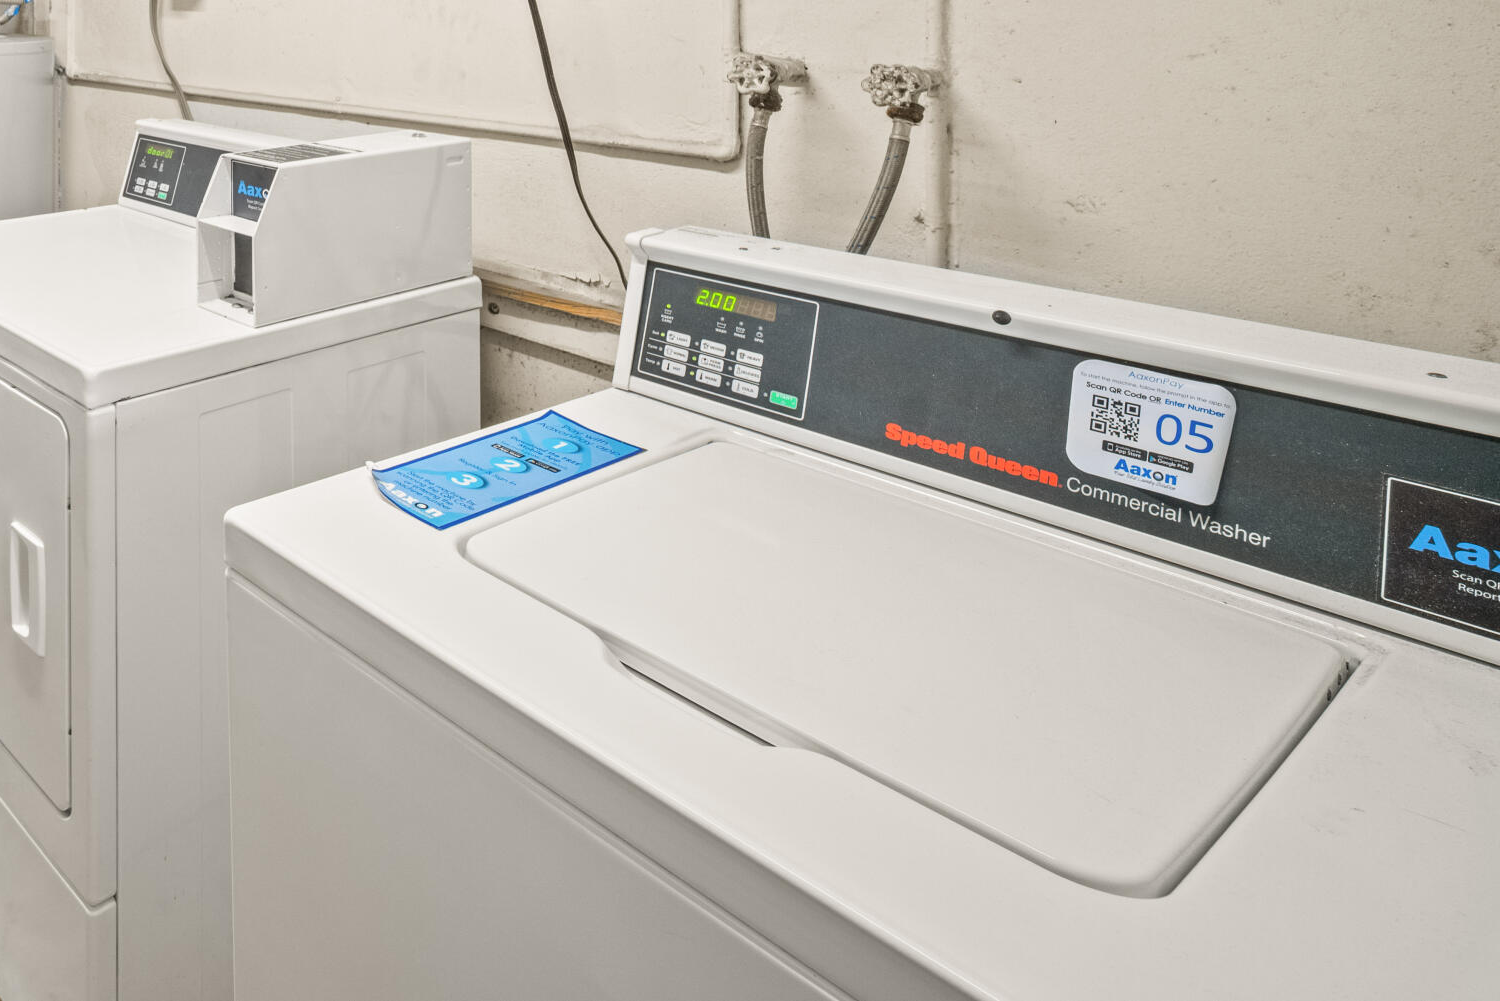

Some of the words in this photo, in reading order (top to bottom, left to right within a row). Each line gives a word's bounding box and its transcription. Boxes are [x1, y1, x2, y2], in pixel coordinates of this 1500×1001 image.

[695, 289, 737, 312] 2.00
[1128, 371, 1185, 390] AaxonPay
[1086, 381, 1107, 392] Scan
[1109, 386, 1122, 395] QR
[1124, 389, 1148, 400] Code
[1149, 395, 1162, 404] OR
[1164, 398, 1186, 409] Enter
[1188, 404, 1226, 419] Number
[1155, 413, 1214, 454] 05
[553, 441, 568, 450] 1
[1128, 450, 1142, 458] Store
[495, 459, 521, 472] 2
[1114, 458, 1177, 486] Aaxon
[1158, 458, 1176, 468] Google
[1178, 463, 1190, 472] Play
[451, 474, 478, 486] 3
[885, 422, 967, 461] Speed
[968, 445, 1059, 487] Queen
[1066, 477, 1182, 523] Commercial
[1189, 510, 1271, 549] Washer
[379, 481, 443, 518] Aaxon
[1452, 569, 1483, 585] Scan
